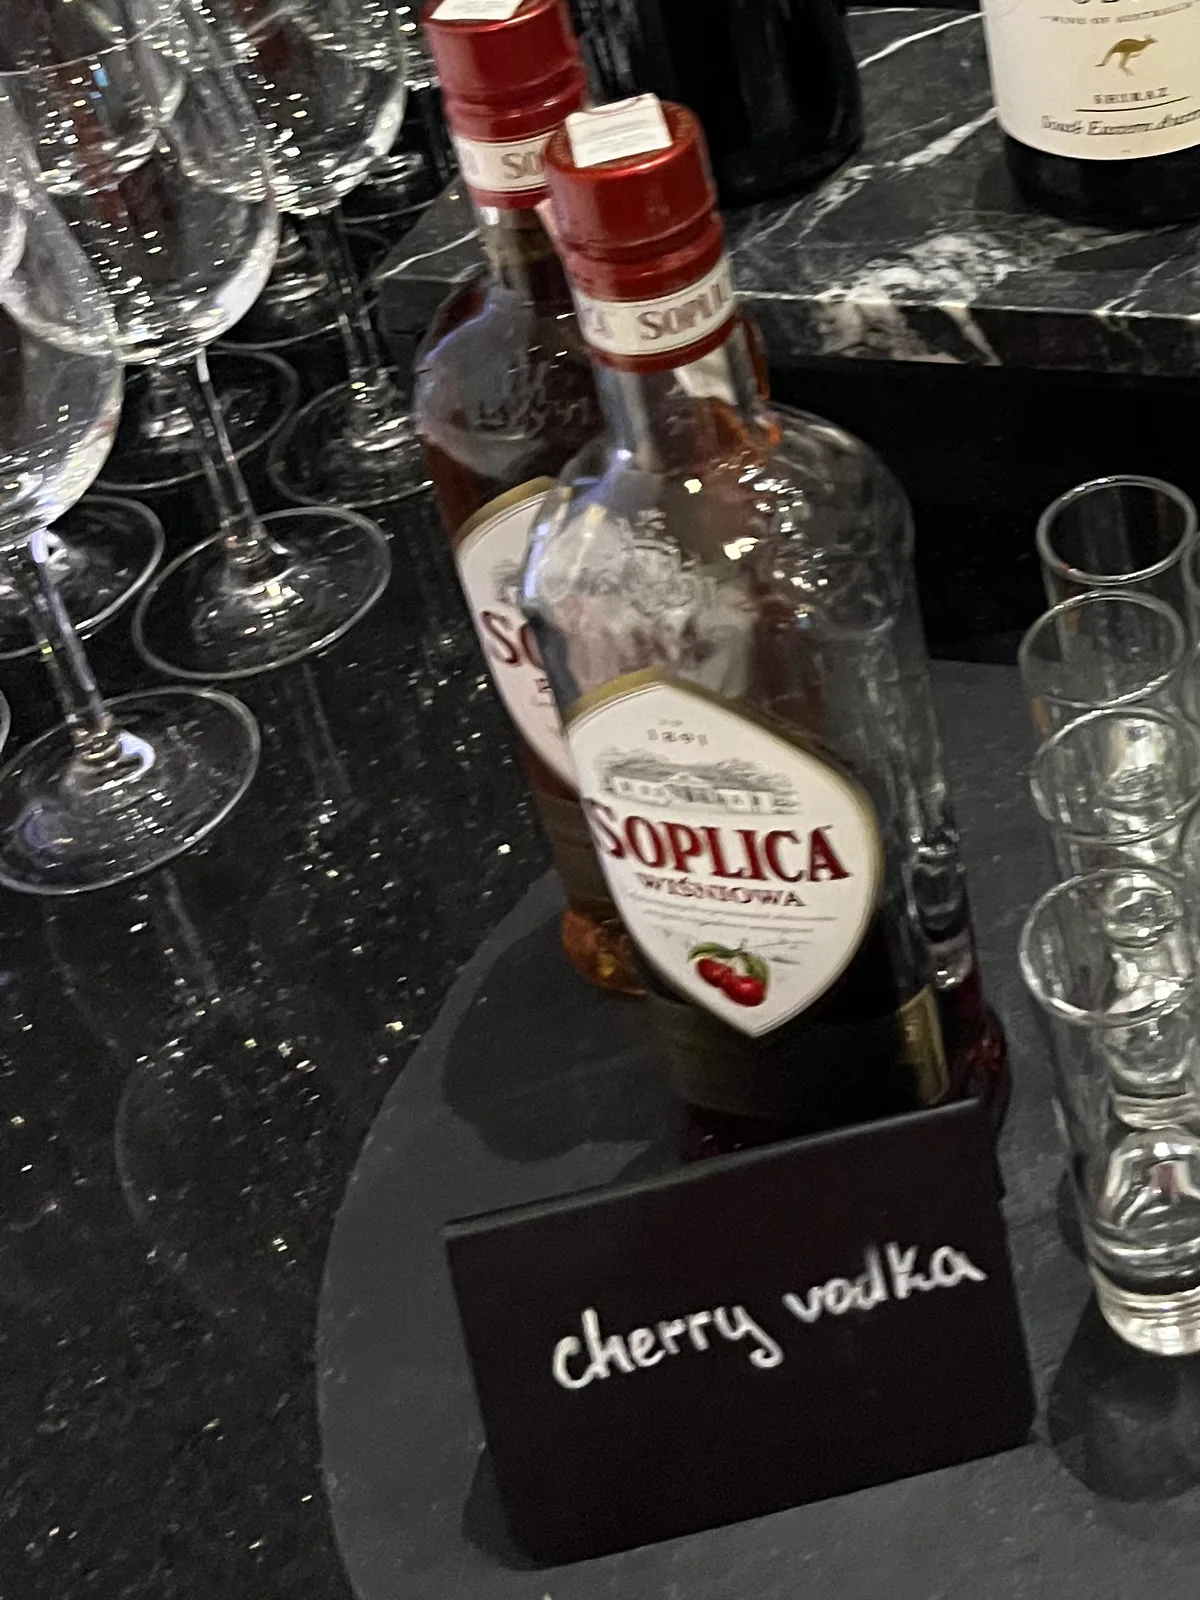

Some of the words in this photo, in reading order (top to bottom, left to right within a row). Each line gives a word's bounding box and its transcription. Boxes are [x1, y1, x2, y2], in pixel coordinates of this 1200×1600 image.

[1093, 87, 1169, 105] SHIRAZ
[585, 797, 854, 883] SOPLICA
[636, 871, 806, 907] WIŚNIOWA
[551, 1307, 785, 1390] cherry
[781, 1241, 988, 1323] vodka
